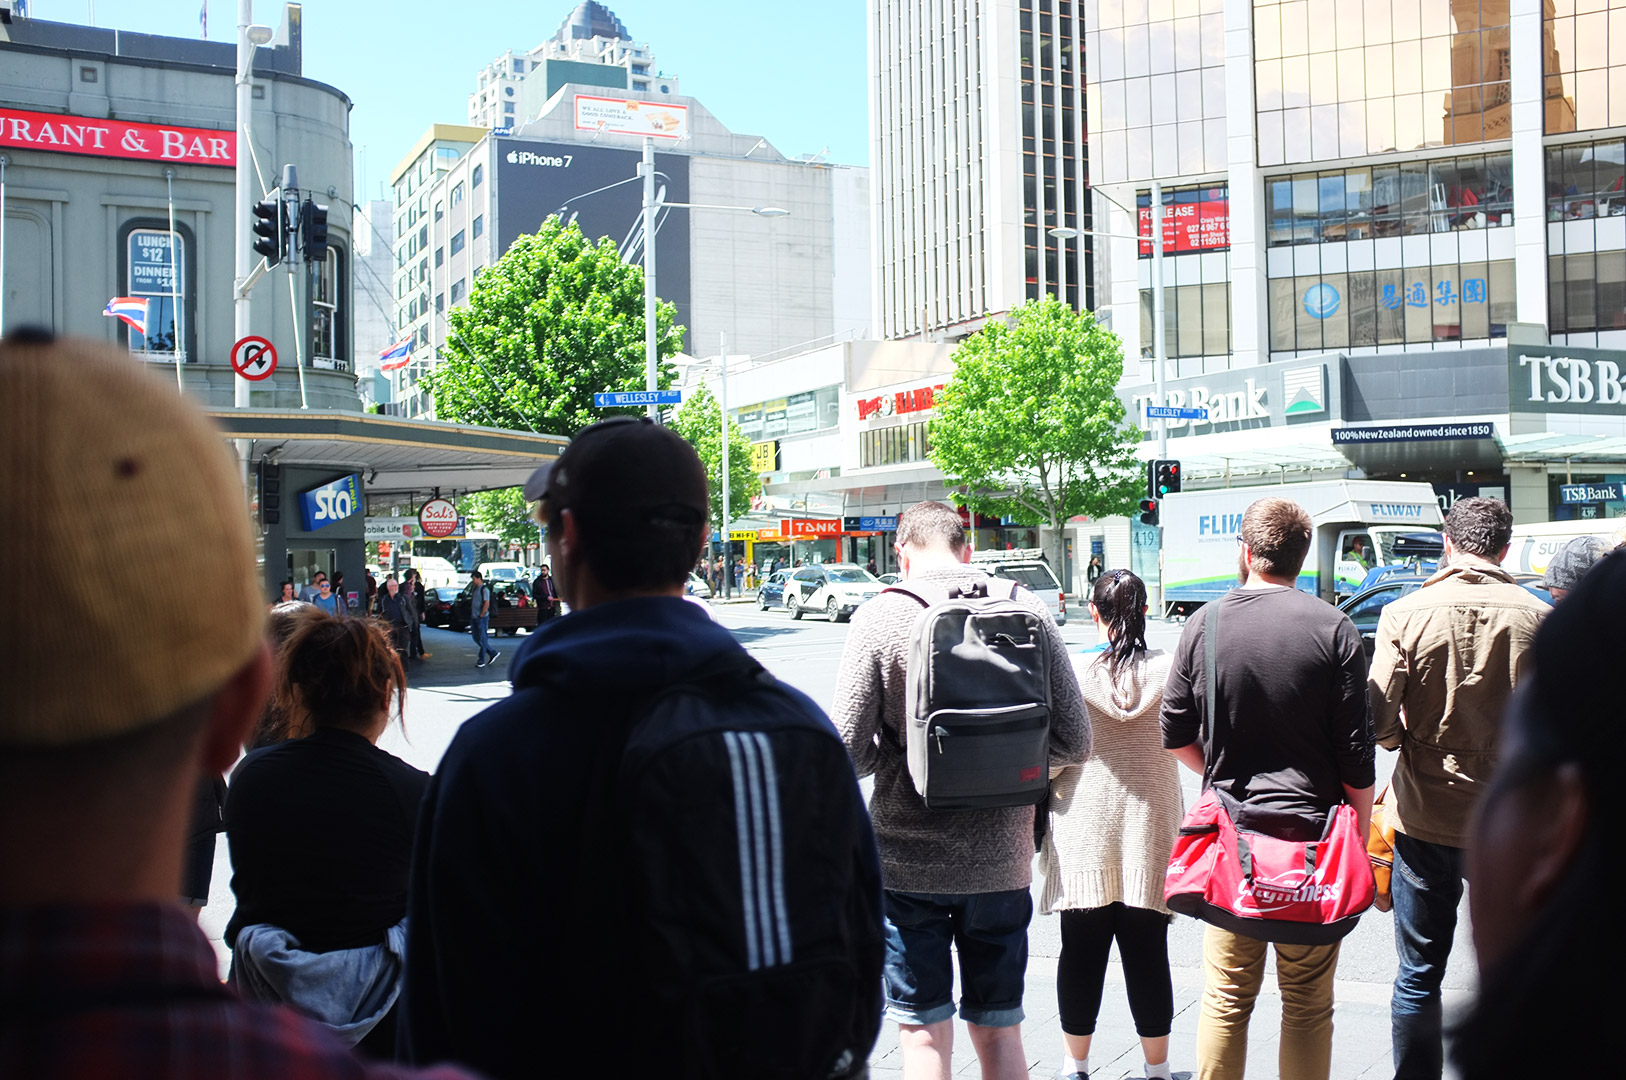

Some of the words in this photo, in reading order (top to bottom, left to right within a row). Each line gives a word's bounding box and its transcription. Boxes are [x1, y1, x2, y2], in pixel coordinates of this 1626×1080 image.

[121, 129, 149, 152] &
[518, 151, 563, 167] iPhone
[563, 155, 573, 167] 7
[142, 247, 163, 262] $12
[1378, 278, 1487, 310] 易通集團
[1519, 354, 1594, 403] TSB
[615, 392, 658, 404] WELLESLEY
[1189, 378, 1270, 427] Bank
[1149, 407, 1181, 417] WELLESLEY
[1335, 430, 1358, 441] 100%
[1359, 429, 1379, 439] New
[1379, 427, 1412, 439] Zealand
[1414, 426, 1444, 437] owned
[1444, 426, 1468, 437] since
[1468, 425, 1490, 435] 1850
[756, 444, 769, 459] JB
[348, 475, 358, 513] TRAVEL
[1562, 486, 1587, 502] TSB
[1587, 485, 1618, 500] Bank
[315, 484, 351, 520] sta
[1370, 503, 1422, 516] FLIWAY
[425, 505, 455, 520] Sal's
[387, 523, 401, 532] Life
[736, 531, 755, 539] HI-FI
[795, 522, 837, 533] TANK
[1133, 531, 1155, 547] 4.19
